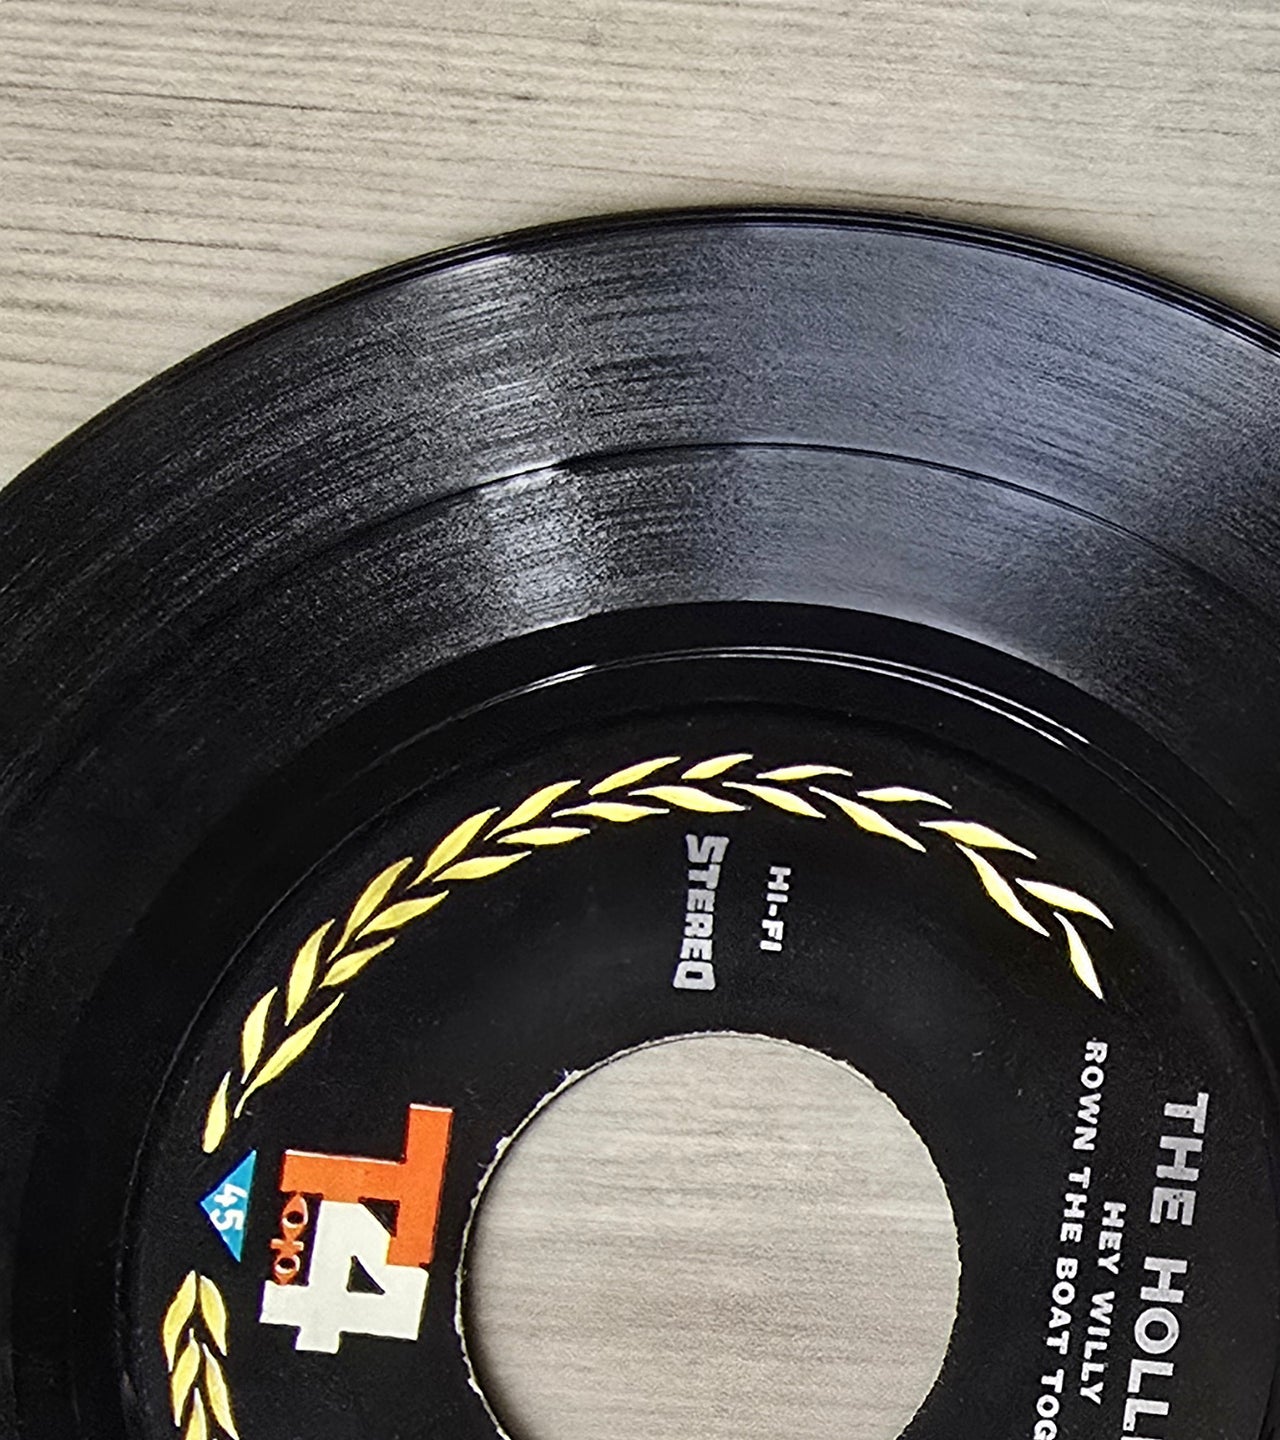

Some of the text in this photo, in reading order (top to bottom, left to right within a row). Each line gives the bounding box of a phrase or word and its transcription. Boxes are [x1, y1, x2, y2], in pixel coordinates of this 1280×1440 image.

[672, 833, 731, 991] STEREO
[759, 865, 792, 953] HI-FI
[1072, 1038, 1109, 1152] ROWN
[209, 1182, 248, 1232] 45
[1059, 1166, 1090, 1244] THE
[1149, 1091, 1209, 1226] THE
[1044, 1256, 1078, 1355] BOAT
[1078, 1201, 1127, 1406] HEY WILLY
